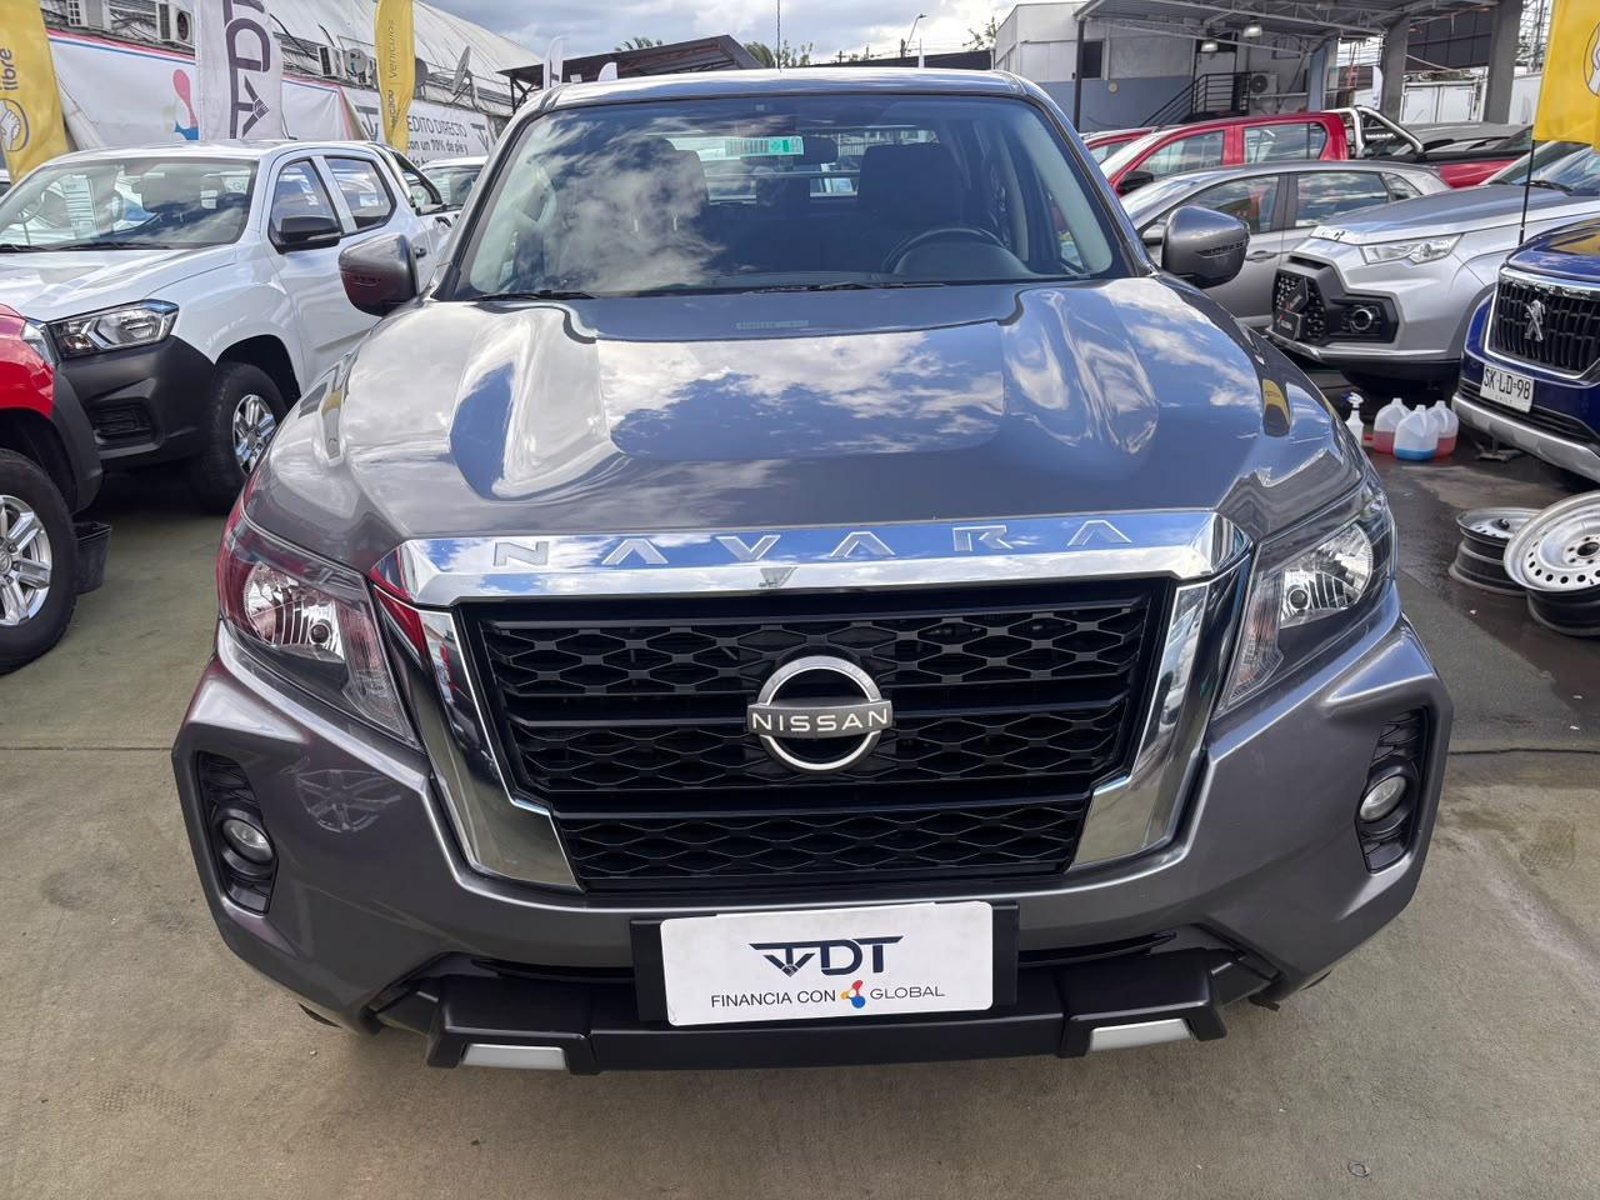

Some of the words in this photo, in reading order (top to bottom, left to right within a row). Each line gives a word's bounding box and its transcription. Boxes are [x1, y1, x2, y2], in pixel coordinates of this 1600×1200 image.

[492, 519, 1133, 568] NAVARA
[752, 708, 888, 732] NISSAN
[711, 992, 793, 1008] FINANCIA
[797, 989, 836, 1005] CON
[869, 985, 946, 1001] GLOBAL
